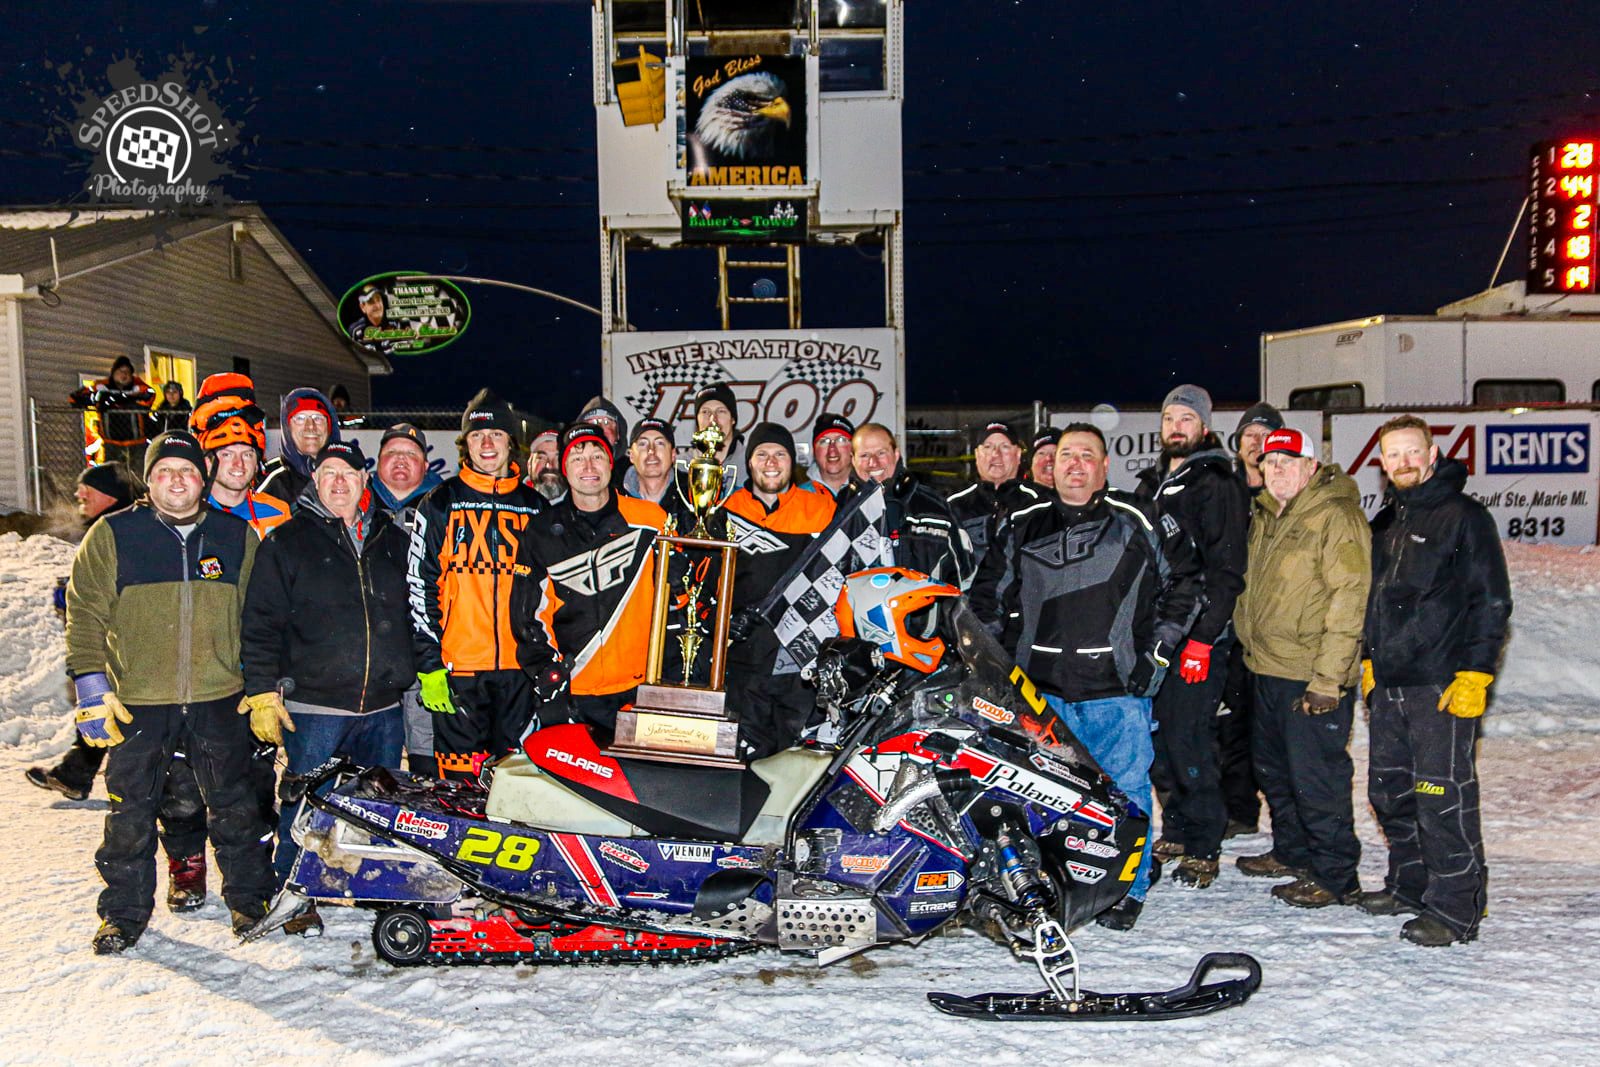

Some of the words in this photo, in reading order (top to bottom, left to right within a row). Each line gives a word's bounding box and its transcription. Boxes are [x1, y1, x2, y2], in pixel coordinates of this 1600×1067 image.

[693, 74, 720, 98] God
[725, 54, 762, 79] Bless
[1561, 143, 1594, 168] 28
[690, 165, 803, 186] AMERICA
[1546, 177, 1557, 196] 2
[1561, 175, 1593, 198] 44
[689, 215, 740, 227] Bauer's
[751, 215, 797, 227] Tower
[1546, 207, 1556, 227] 3
[1573, 204, 1591, 229] 2
[1545, 238, 1556, 257] 4
[1545, 269, 1555, 287] 5
[393, 286, 419, 295] THANK
[420, 285, 434, 294] YOU
[626, 339, 881, 374] INTERNATIONAL
[1491, 431, 1586, 466] RENTS
[1505, 492, 1530, 507] Ste.
[1533, 491, 1567, 507] Marie
[1509, 516, 1565, 538] 8313
[545, 748, 614, 779] POLARIS
[984, 763, 1072, 811] Polaris
[396, 823, 433, 838] Racing
[397, 811, 448, 832] Nelson
[456, 827, 541, 872] 28
[600, 842, 632, 863] TRACKS
[632, 858, 650, 871] USA
[675, 845, 712, 858] VENOM
[910, 901, 958, 912] EXTREME
